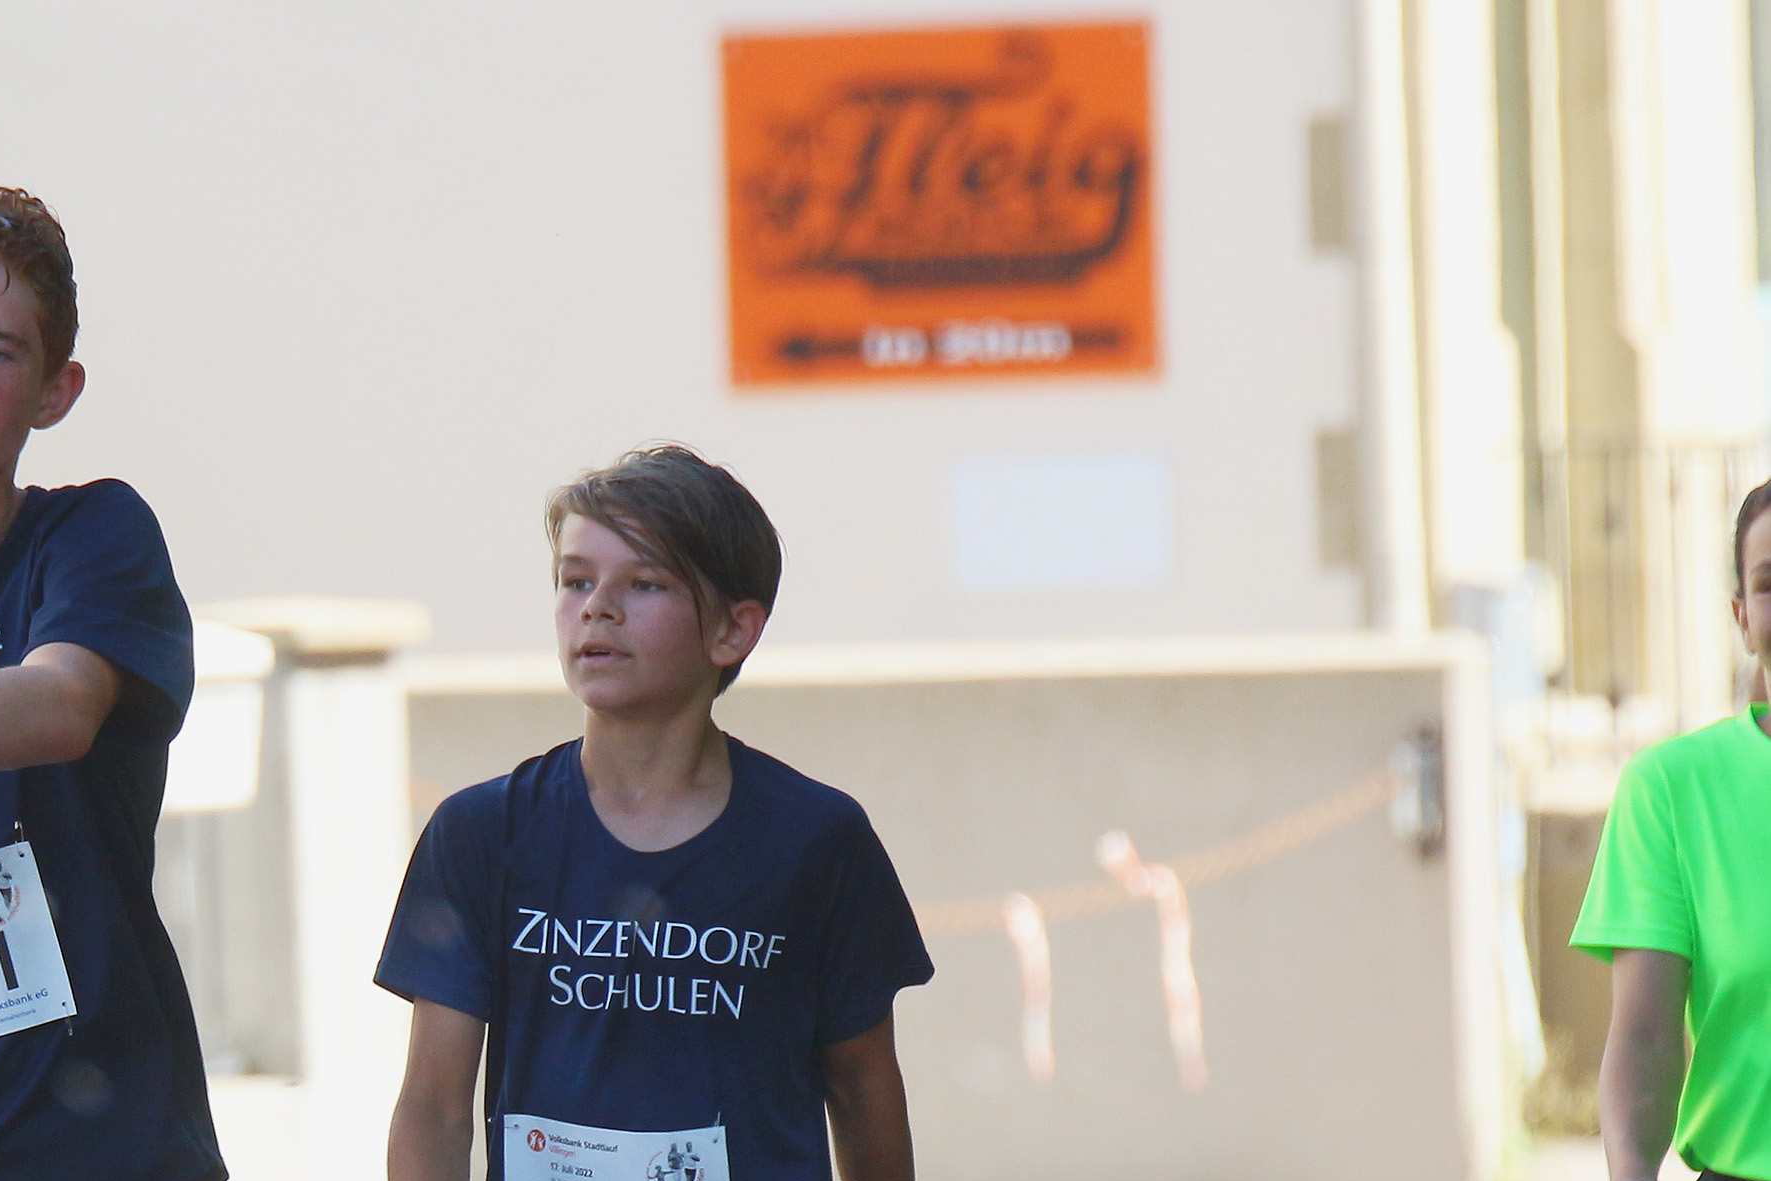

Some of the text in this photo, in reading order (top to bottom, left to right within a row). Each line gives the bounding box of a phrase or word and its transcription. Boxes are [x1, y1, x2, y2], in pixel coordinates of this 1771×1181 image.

[512, 907, 786, 969] ZINZENDORF
[35, 988, 49, 999] eG
[548, 964, 745, 1020] SCHULEN
[574, 1167, 594, 1178] 2022
